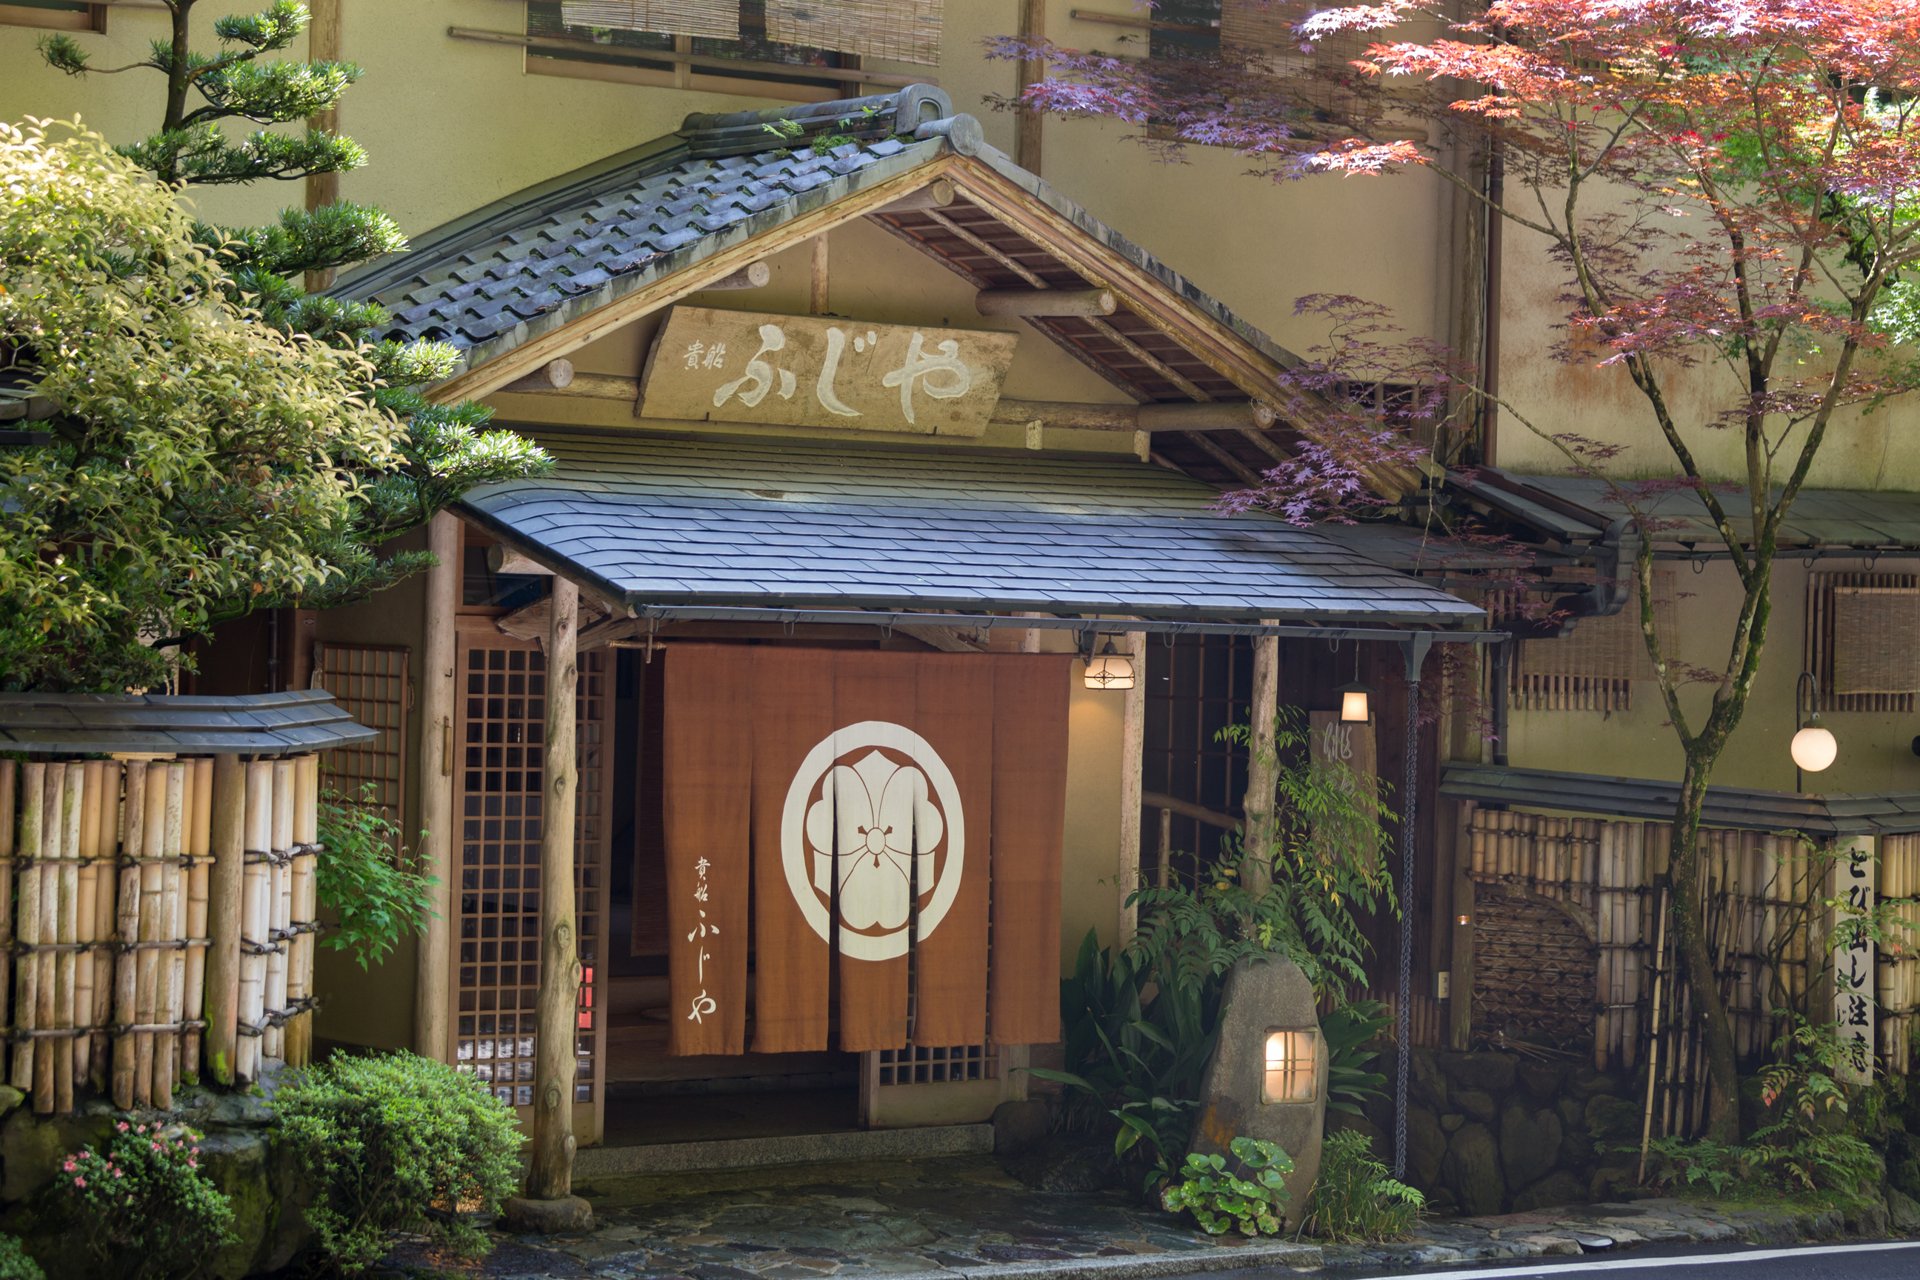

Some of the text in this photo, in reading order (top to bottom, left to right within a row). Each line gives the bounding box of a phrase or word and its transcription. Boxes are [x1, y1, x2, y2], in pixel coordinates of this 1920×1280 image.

[683, 324, 971, 424] 貴船 ふじや
